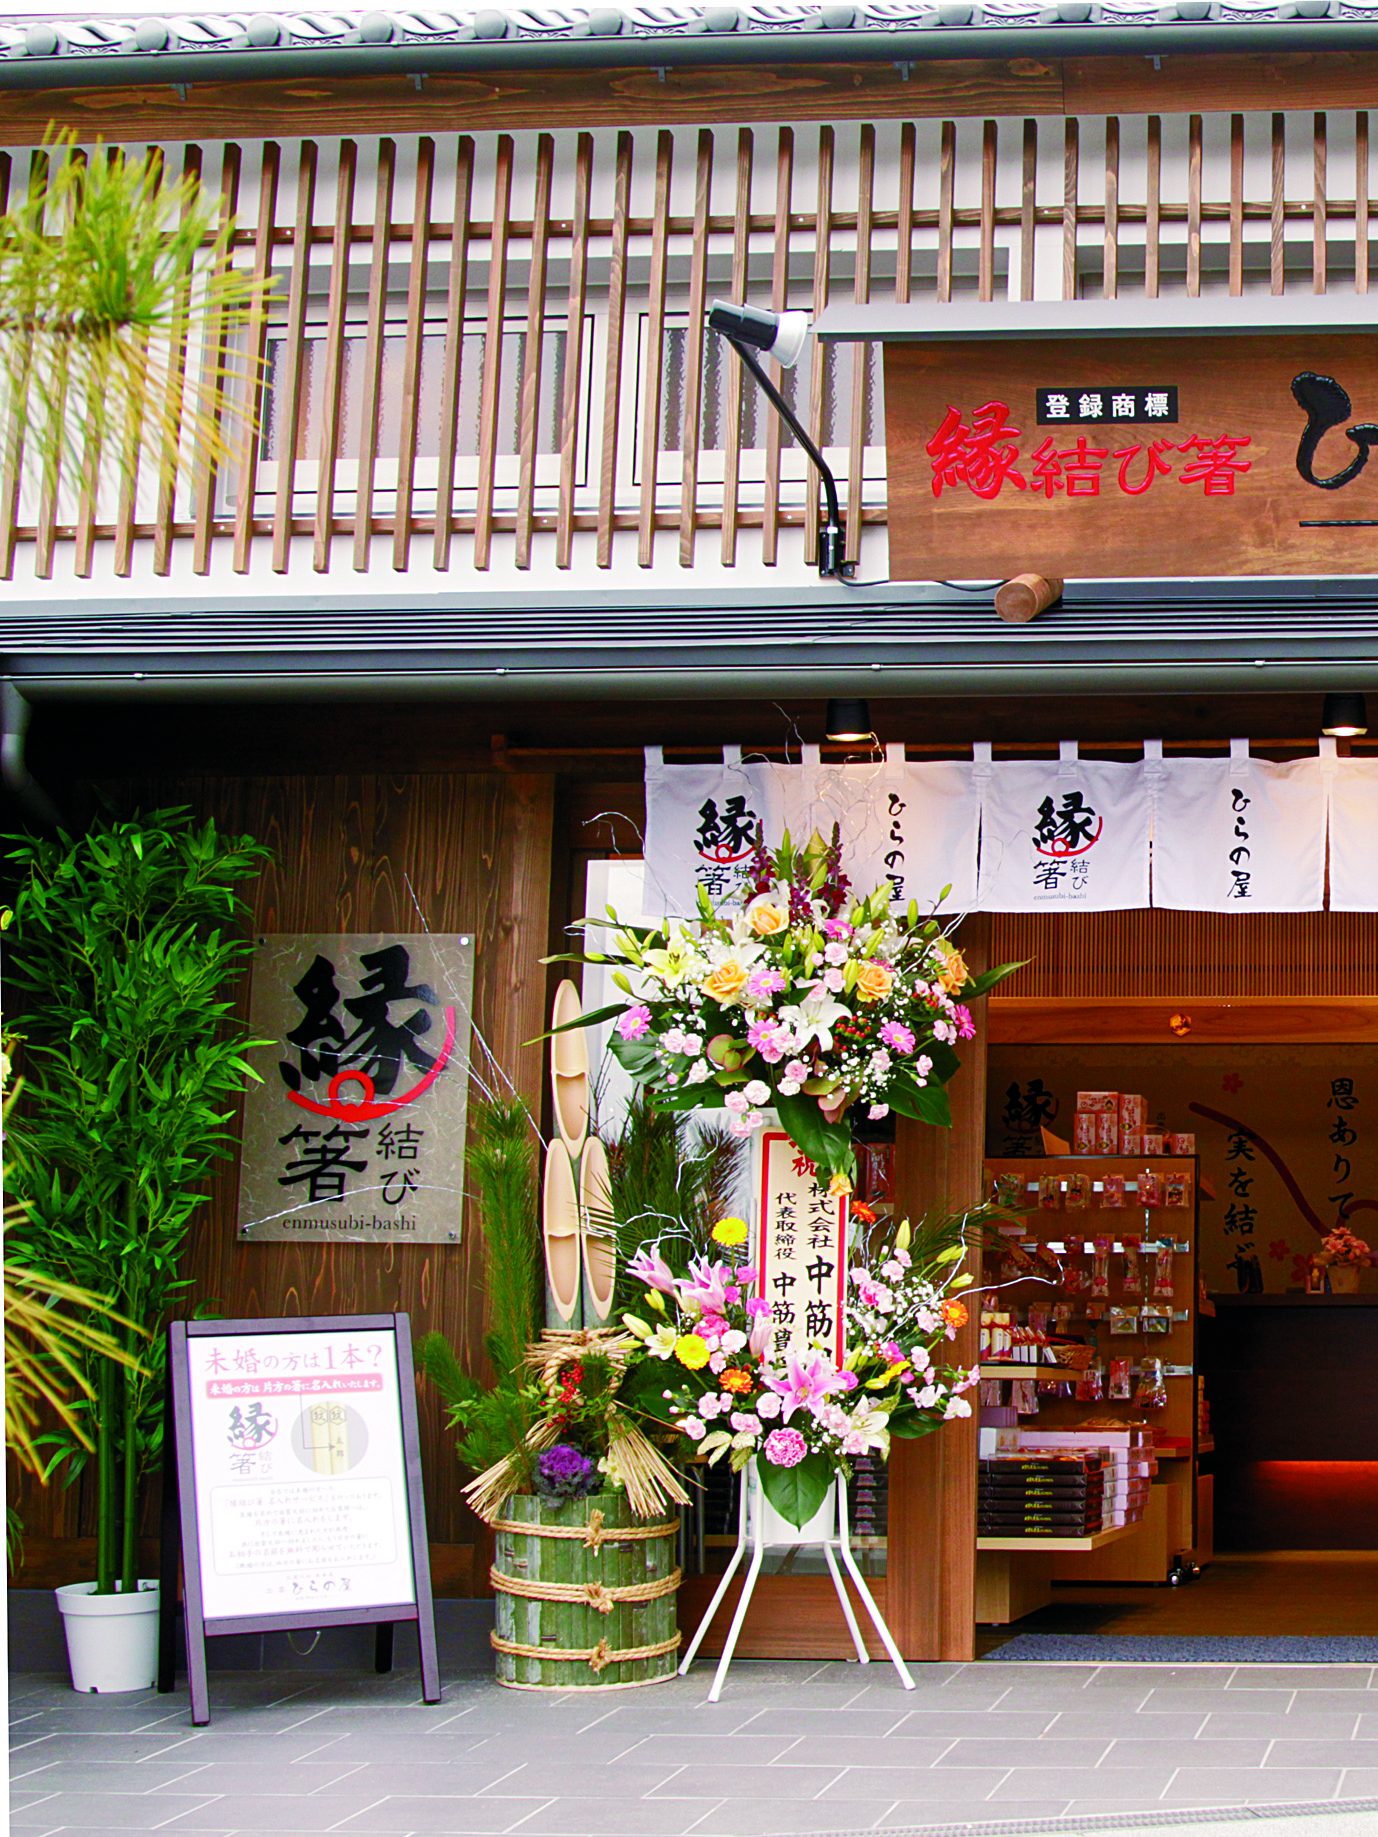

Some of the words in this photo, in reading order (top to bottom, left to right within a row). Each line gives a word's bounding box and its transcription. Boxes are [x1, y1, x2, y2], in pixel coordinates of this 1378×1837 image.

[1045, 393, 1170, 421] 登録商標
[926, 401, 1252, 501] 縁結び箸
[693, 795, 757, 854] 縁
[884, 792, 907, 902] ひらの屋
[1031, 791, 1097, 850] 縁
[1227, 788, 1253, 899] ひらの屋
[1033, 859, 1067, 891] 箸
[1071, 859, 1090, 890] 結び
[278, 944, 448, 1096] 縁
[1002, 1078, 1055, 1127] 縁
[277, 1123, 371, 1204] 箸
[375, 1122, 425, 1206] 結び
[1327, 1077, 1359, 1220] 恩ありて
[282, 1215, 418, 1231] enmusubi-bashi
[774, 1192, 798, 1260] 代表取締役
[227, 1402, 273, 1444] 縁
